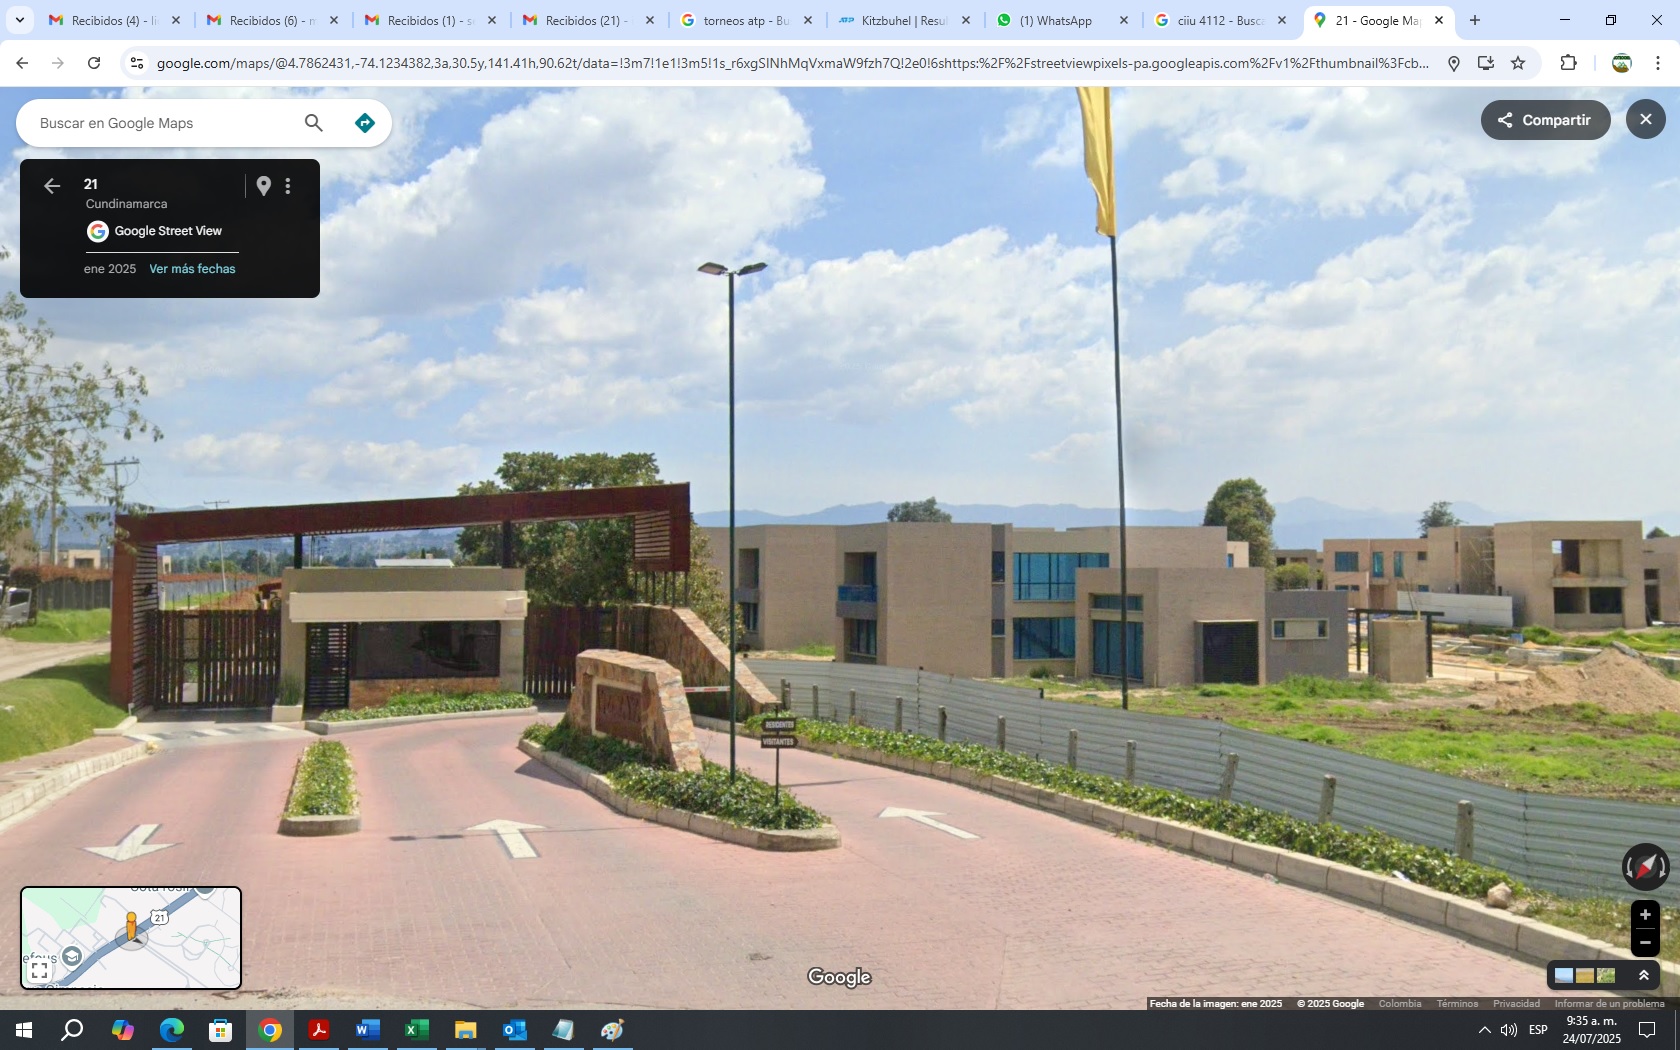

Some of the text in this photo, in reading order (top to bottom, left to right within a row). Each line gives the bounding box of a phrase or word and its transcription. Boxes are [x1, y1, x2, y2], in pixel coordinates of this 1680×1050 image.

[72, 15, 123, 26] Recibidos
[126, 15, 140, 28] (4)
[230, 15, 281, 26] Recibidos
[284, 15, 298, 28] (6)
[388, 15, 439, 26] Recibidos
[442, 15, 456, 28] (1)
[546, 15, 597, 26] Recibidos
[600, 15, 621, 28] (21)
[703, 16, 745, 26] torneos
[747, 16, 766, 29] atp
[862, 15, 912, 26] Kitzbuhel
[1020, 15, 1093, 29] (1) WhatsApp
[1177, 15, 1196, 26] ciiu
[1198, 15, 1226, 26] 4112
[1335, 15, 1348, 26] 21
[1360, 15, 1400, 29] Google
[40, 116, 194, 132] Buscar en Google Maps
[1522, 113, 1592, 129] Compartir
[83, 177, 98, 190] 21
[85, 197, 168, 209] Cundinamarca
[114, 224, 223, 239] Google Street View
[83, 263, 137, 274] ene 2025
[149, 262, 236, 274] Ver más fechas
[764, 719, 795, 730] RESIDENTES
[762, 737, 795, 747] VISITANTES
[154, 913, 165, 923] 21
[1566, 1015, 1618, 1026] 9:35 a. m.
[1529, 1024, 1549, 1035] ESP
[1562, 1033, 1622, 1045] 24/07/2025
